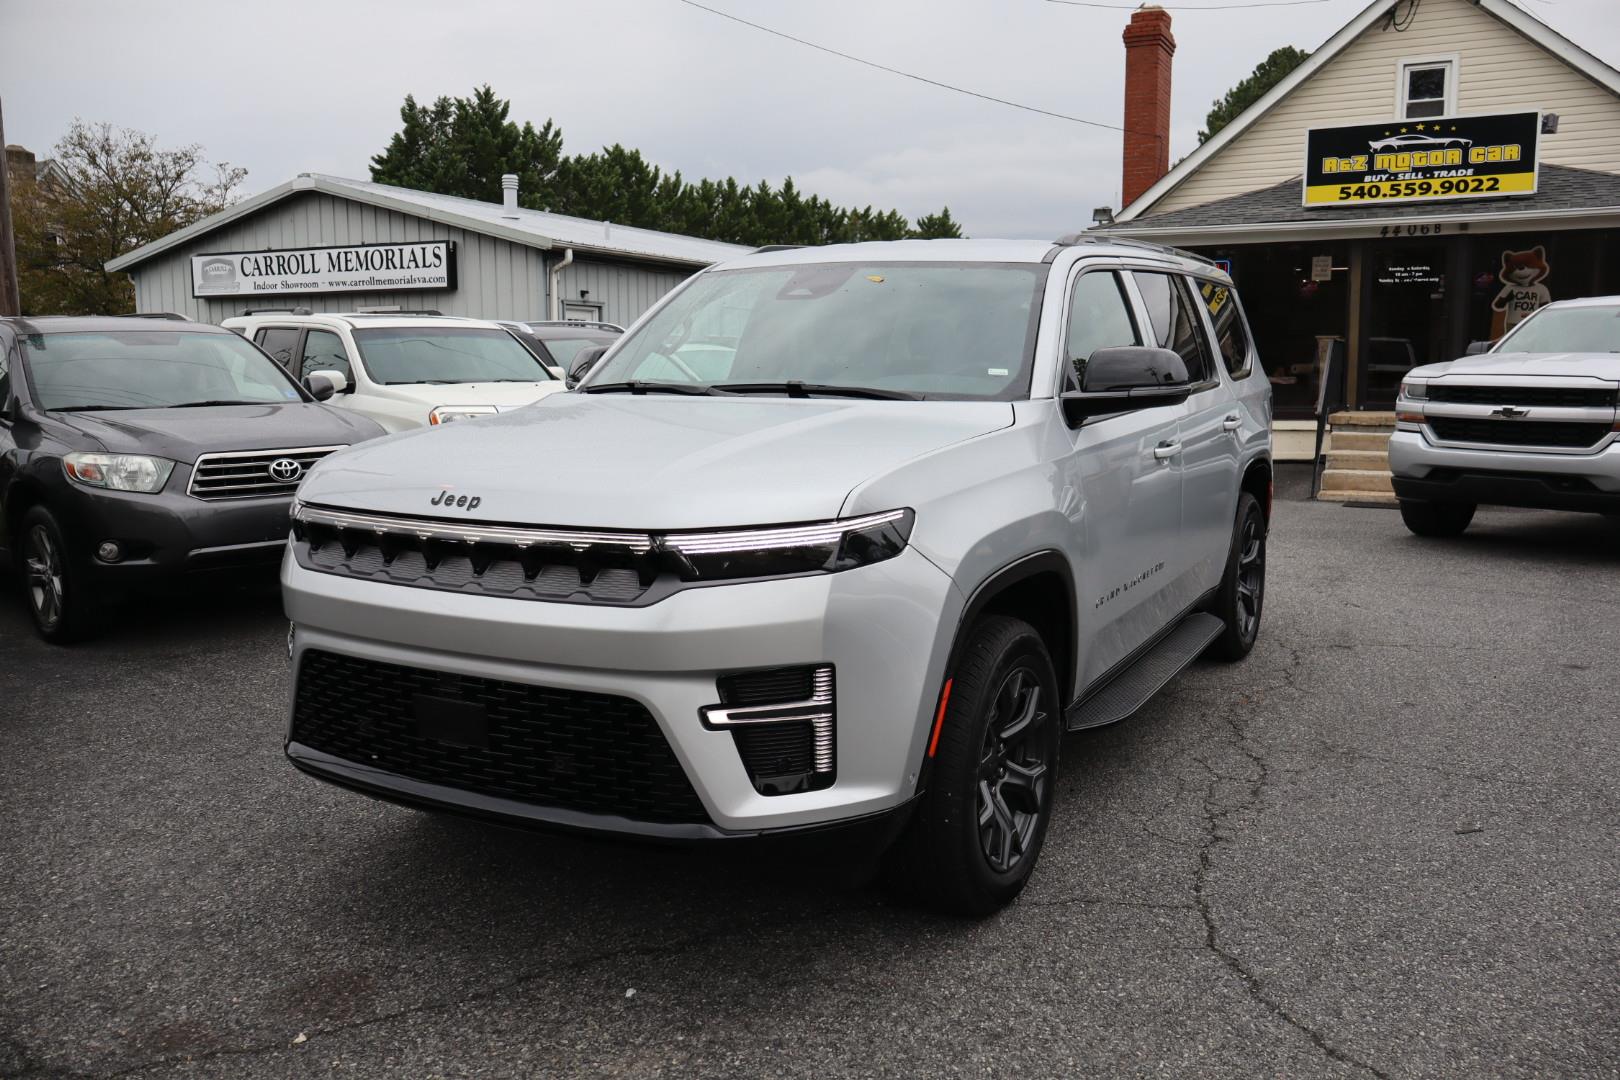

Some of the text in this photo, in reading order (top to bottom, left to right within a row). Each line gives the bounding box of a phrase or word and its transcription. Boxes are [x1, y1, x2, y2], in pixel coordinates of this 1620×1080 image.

[1364, 168, 1475, 183] BUY SELL TRADE
[1338, 177, 1500, 201] 540.559.9022
[240, 245, 443, 278] CARROLL MEMORIALS
[253, 280, 279, 291] Indoor
[280, 279, 319, 290] Showroom
[328, 274, 446, 289] www.carrollmemorialsva.com
[1515, 291, 1538, 301] CAR
[1514, 301, 1536, 312] FOX
[430, 490, 481, 511] Jeep
